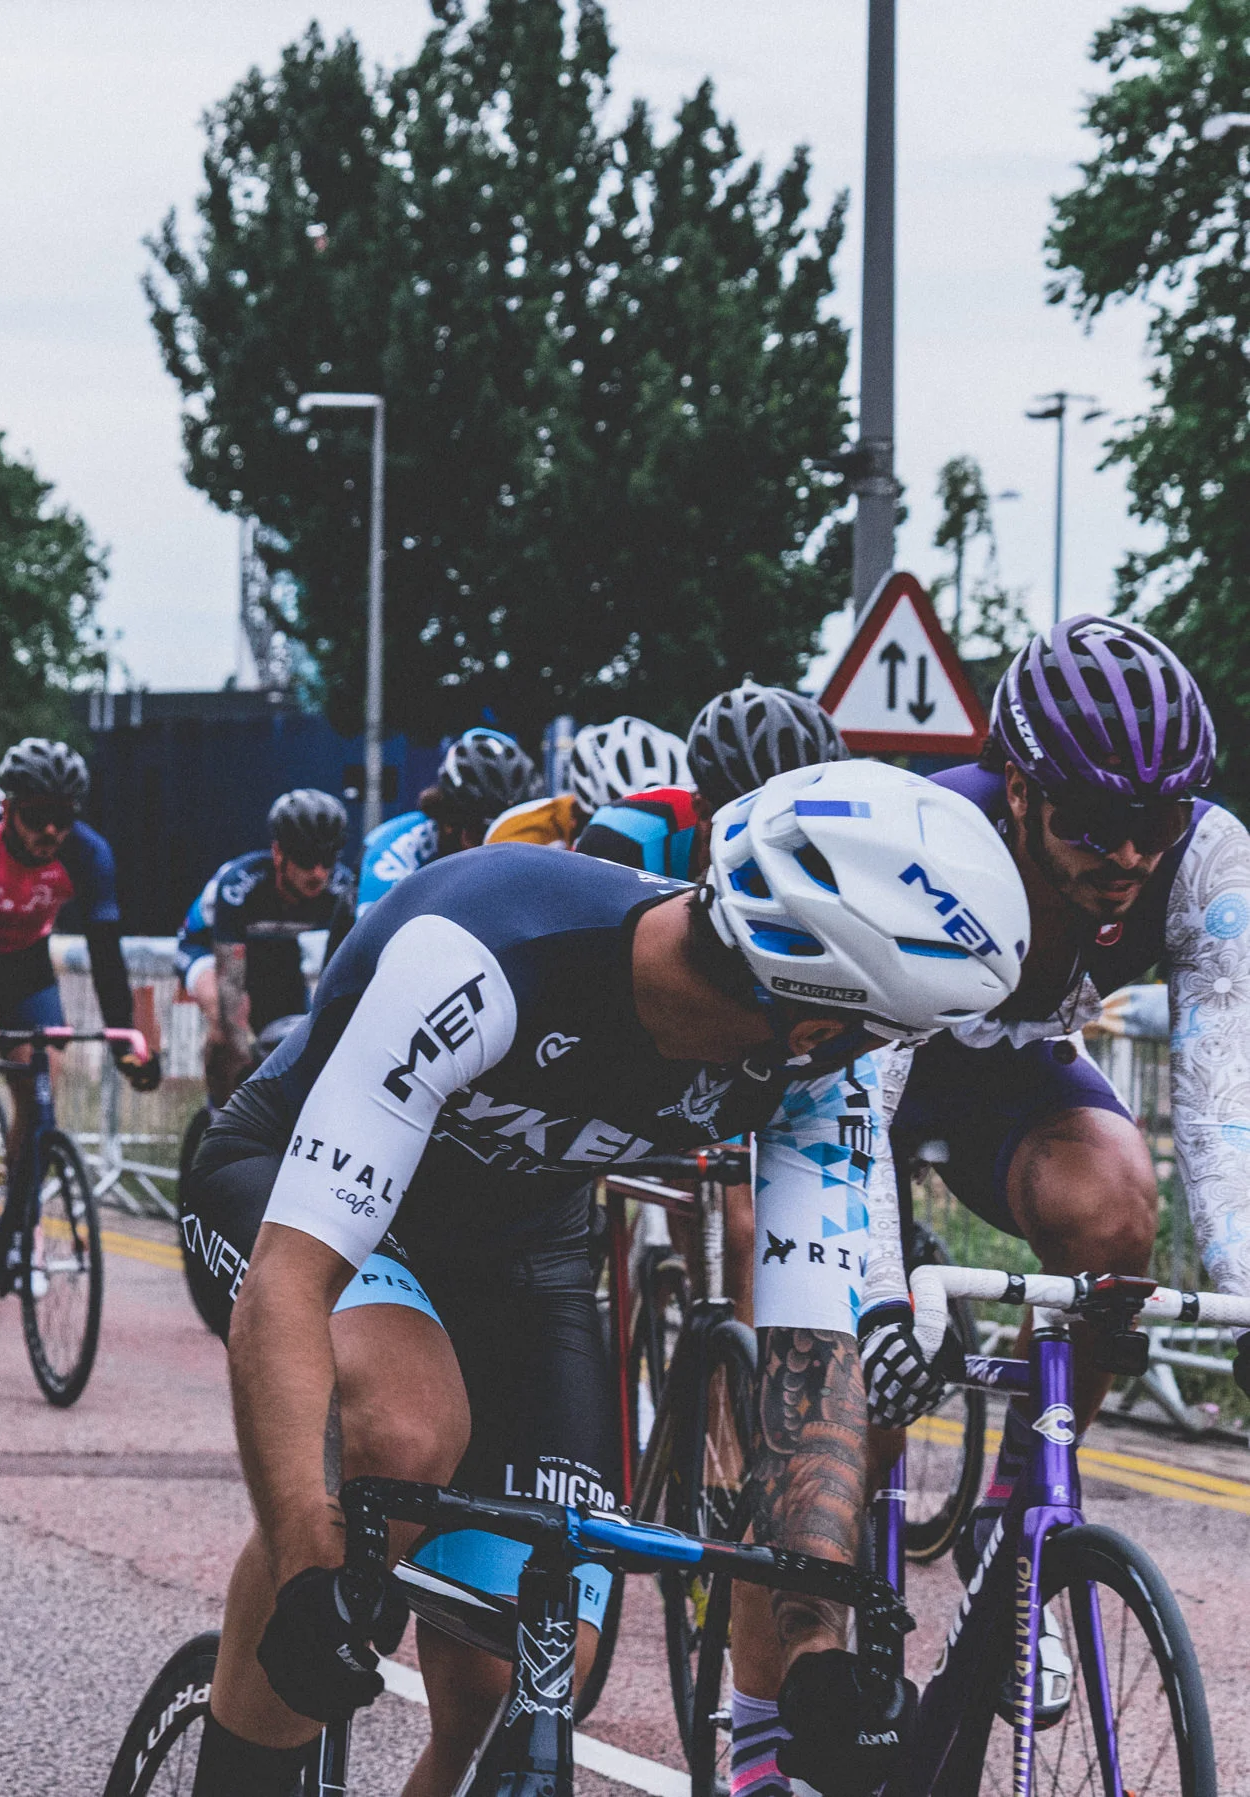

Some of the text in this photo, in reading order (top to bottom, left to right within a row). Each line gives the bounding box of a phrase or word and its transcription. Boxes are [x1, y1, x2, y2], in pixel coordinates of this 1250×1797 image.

[1010, 704, 1044, 760] LAZER
[897, 862, 1003, 957] MET
[790, 982, 864, 1001] MARTINEZ
[381, 971, 487, 1104] MET
[290, 1134, 394, 1205] RIVAL
[539, 1455, 572, 1466] DITTA
